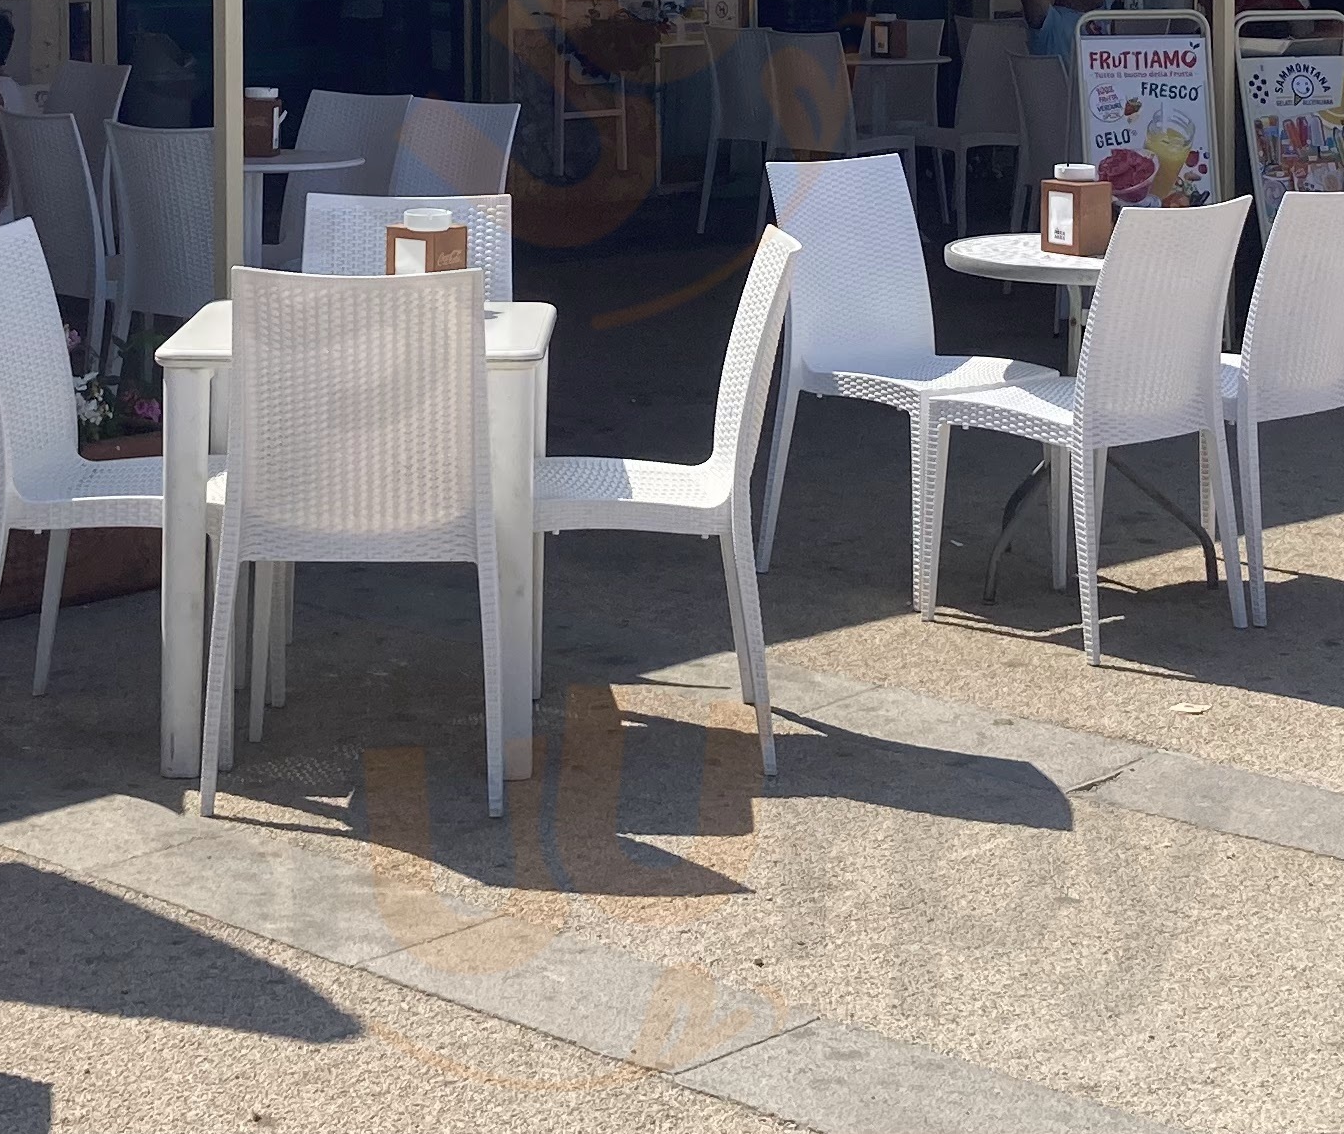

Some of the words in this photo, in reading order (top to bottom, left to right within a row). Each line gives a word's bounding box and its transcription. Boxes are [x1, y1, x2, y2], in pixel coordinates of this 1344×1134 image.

[1275, 62, 1332, 94] SAMMONTANA
[1141, 81, 1201, 102] FRESCO
[1095, 128, 1131, 149] GELO
